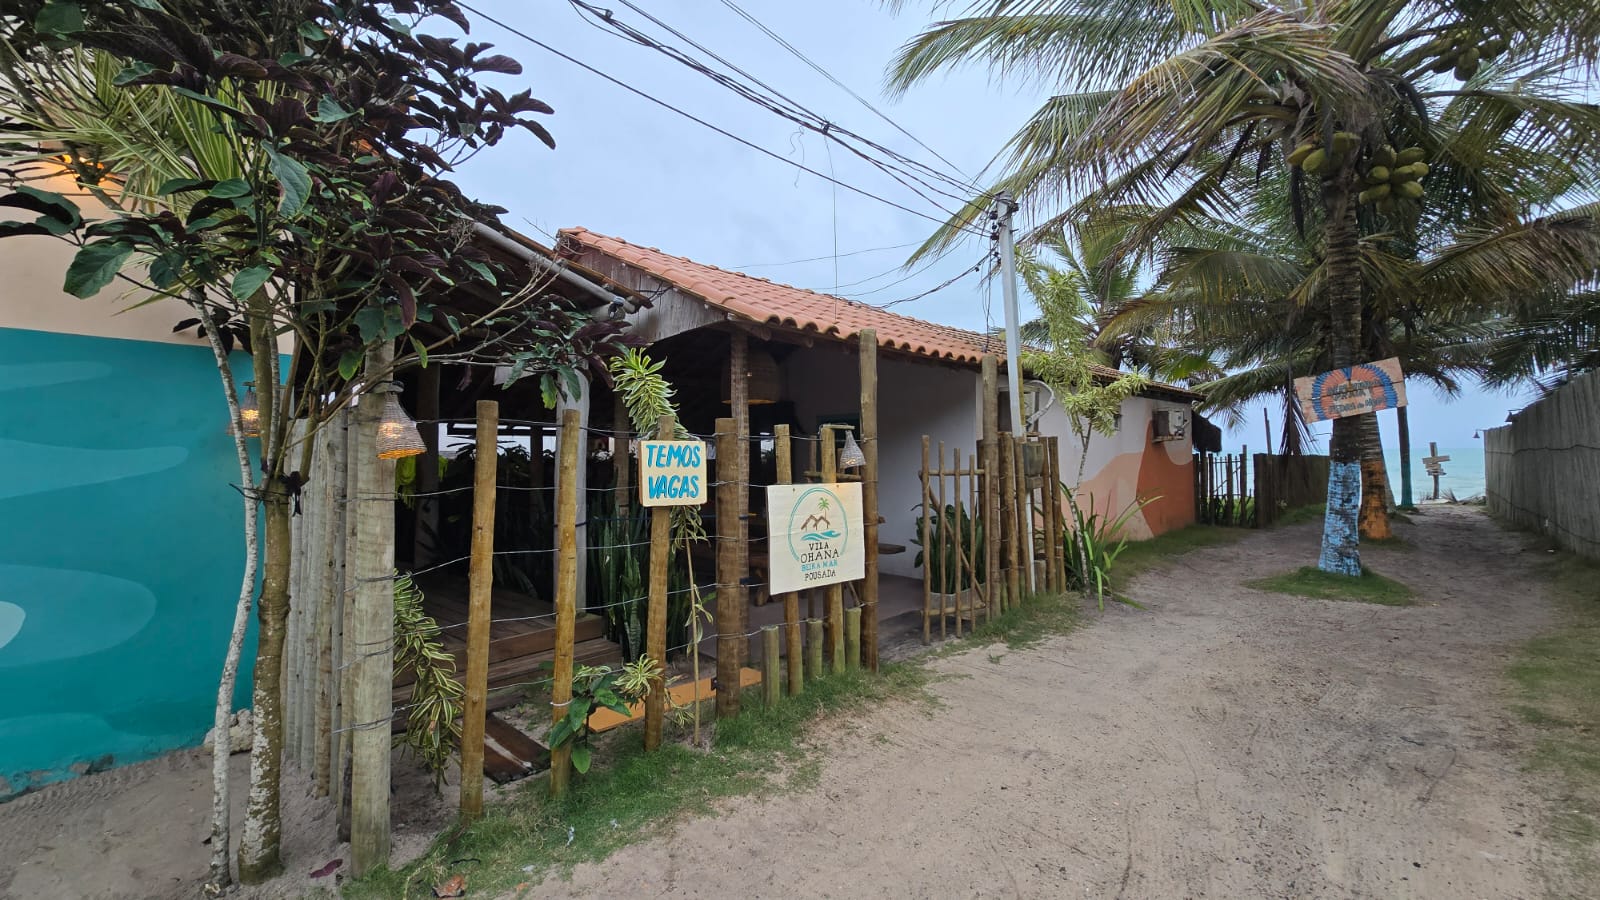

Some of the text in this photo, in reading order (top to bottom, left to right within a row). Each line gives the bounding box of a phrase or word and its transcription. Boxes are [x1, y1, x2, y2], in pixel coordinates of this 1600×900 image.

[646, 444, 701, 468] TEMOS
[648, 475, 699, 499] VAGAS
[808, 542, 830, 551] VILA
[800, 548, 840, 563] OHANA
[801, 559, 838, 572] BEIRA MAR
[804, 569, 837, 581] POUSADA
